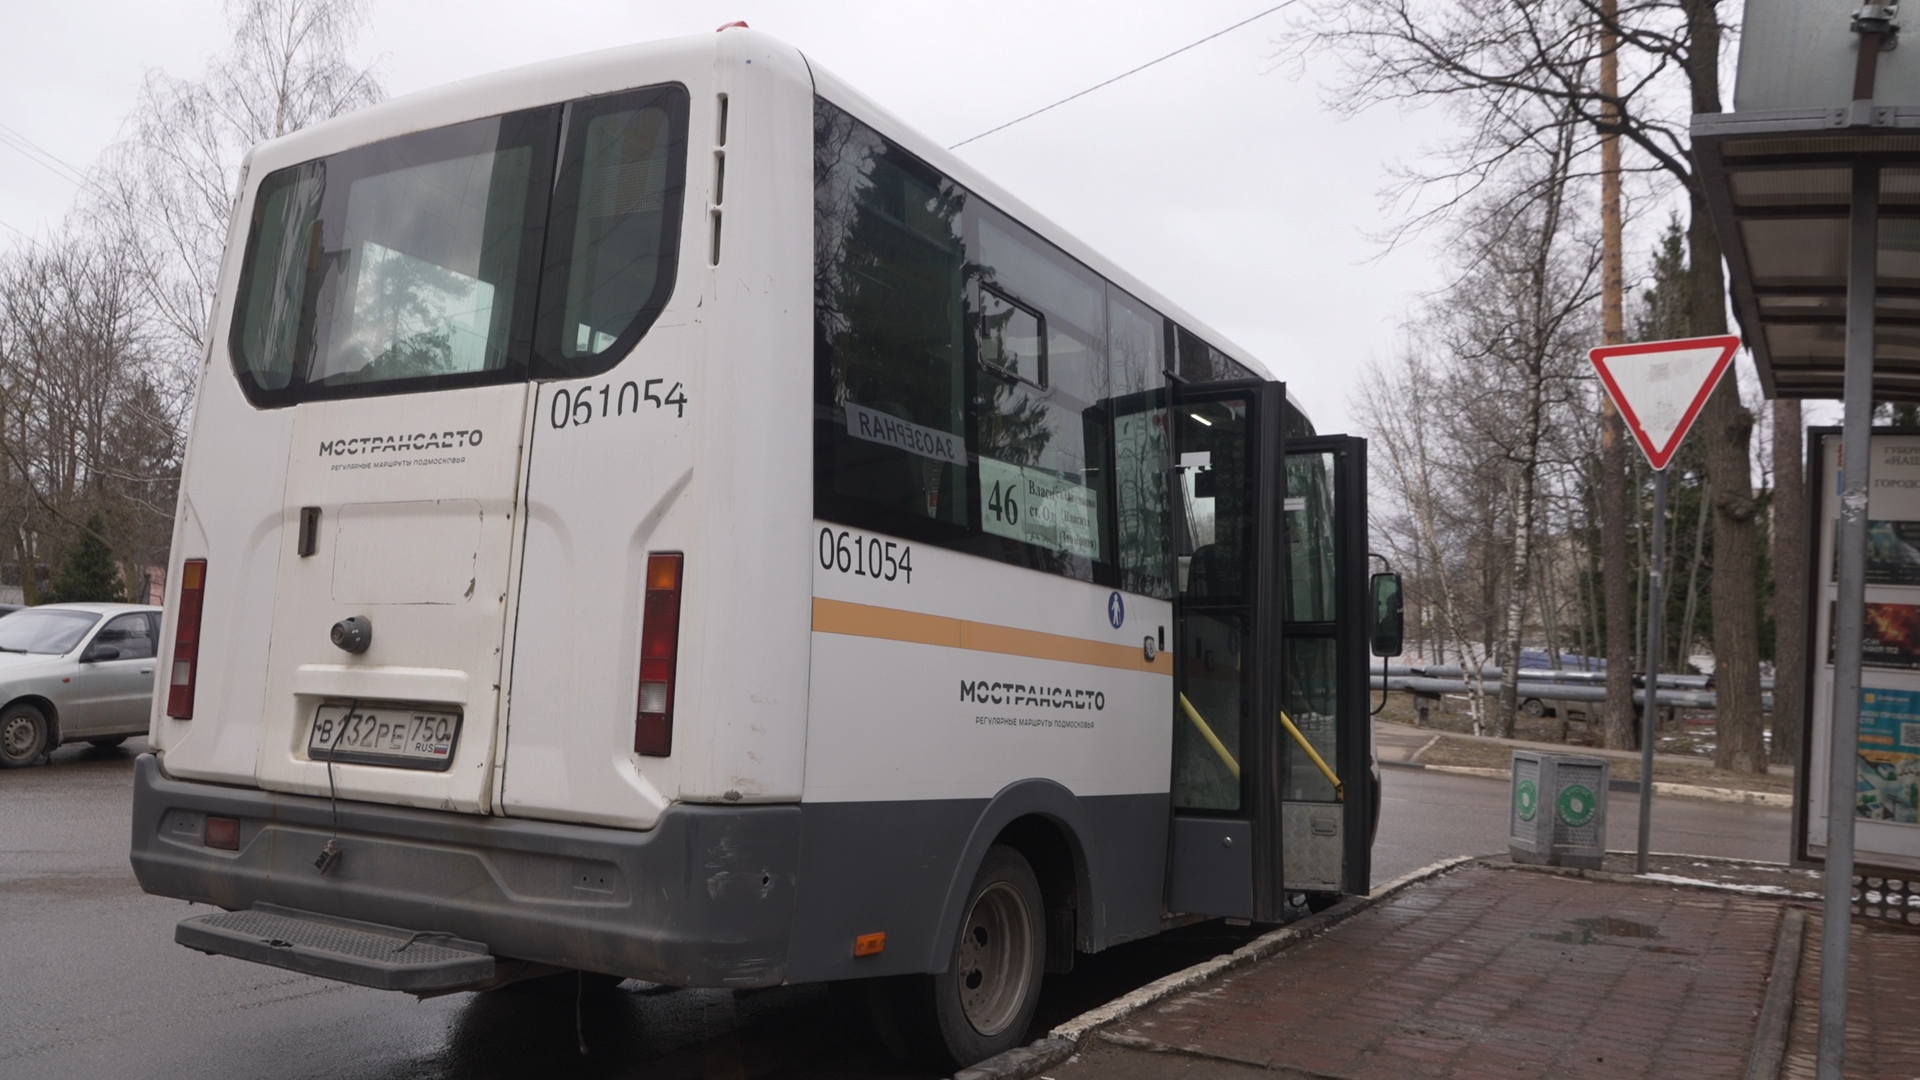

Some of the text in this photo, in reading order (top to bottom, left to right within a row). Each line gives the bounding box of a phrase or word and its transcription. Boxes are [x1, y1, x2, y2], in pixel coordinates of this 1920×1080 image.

[550, 378, 688, 430] 061054
[318, 429, 484, 457] МОСТРАНСАВТО
[330, 456, 466, 471] РЕГУЛЯРНЫЕ МАРШРУТЫ ПОДМОСКОВЬЯ
[988, 479, 1019, 526] 46
[818, 527, 913, 584] 061054
[960, 679, 1105, 711] МОСТРАНСАВТО
[411, 716, 449, 742] 750
[975, 716, 1095, 729] РЕГУЛЯРНЫЕ МАРШРУТЫ ПОДМОСКОВЬЯ
[415, 742, 434, 753] RUS
